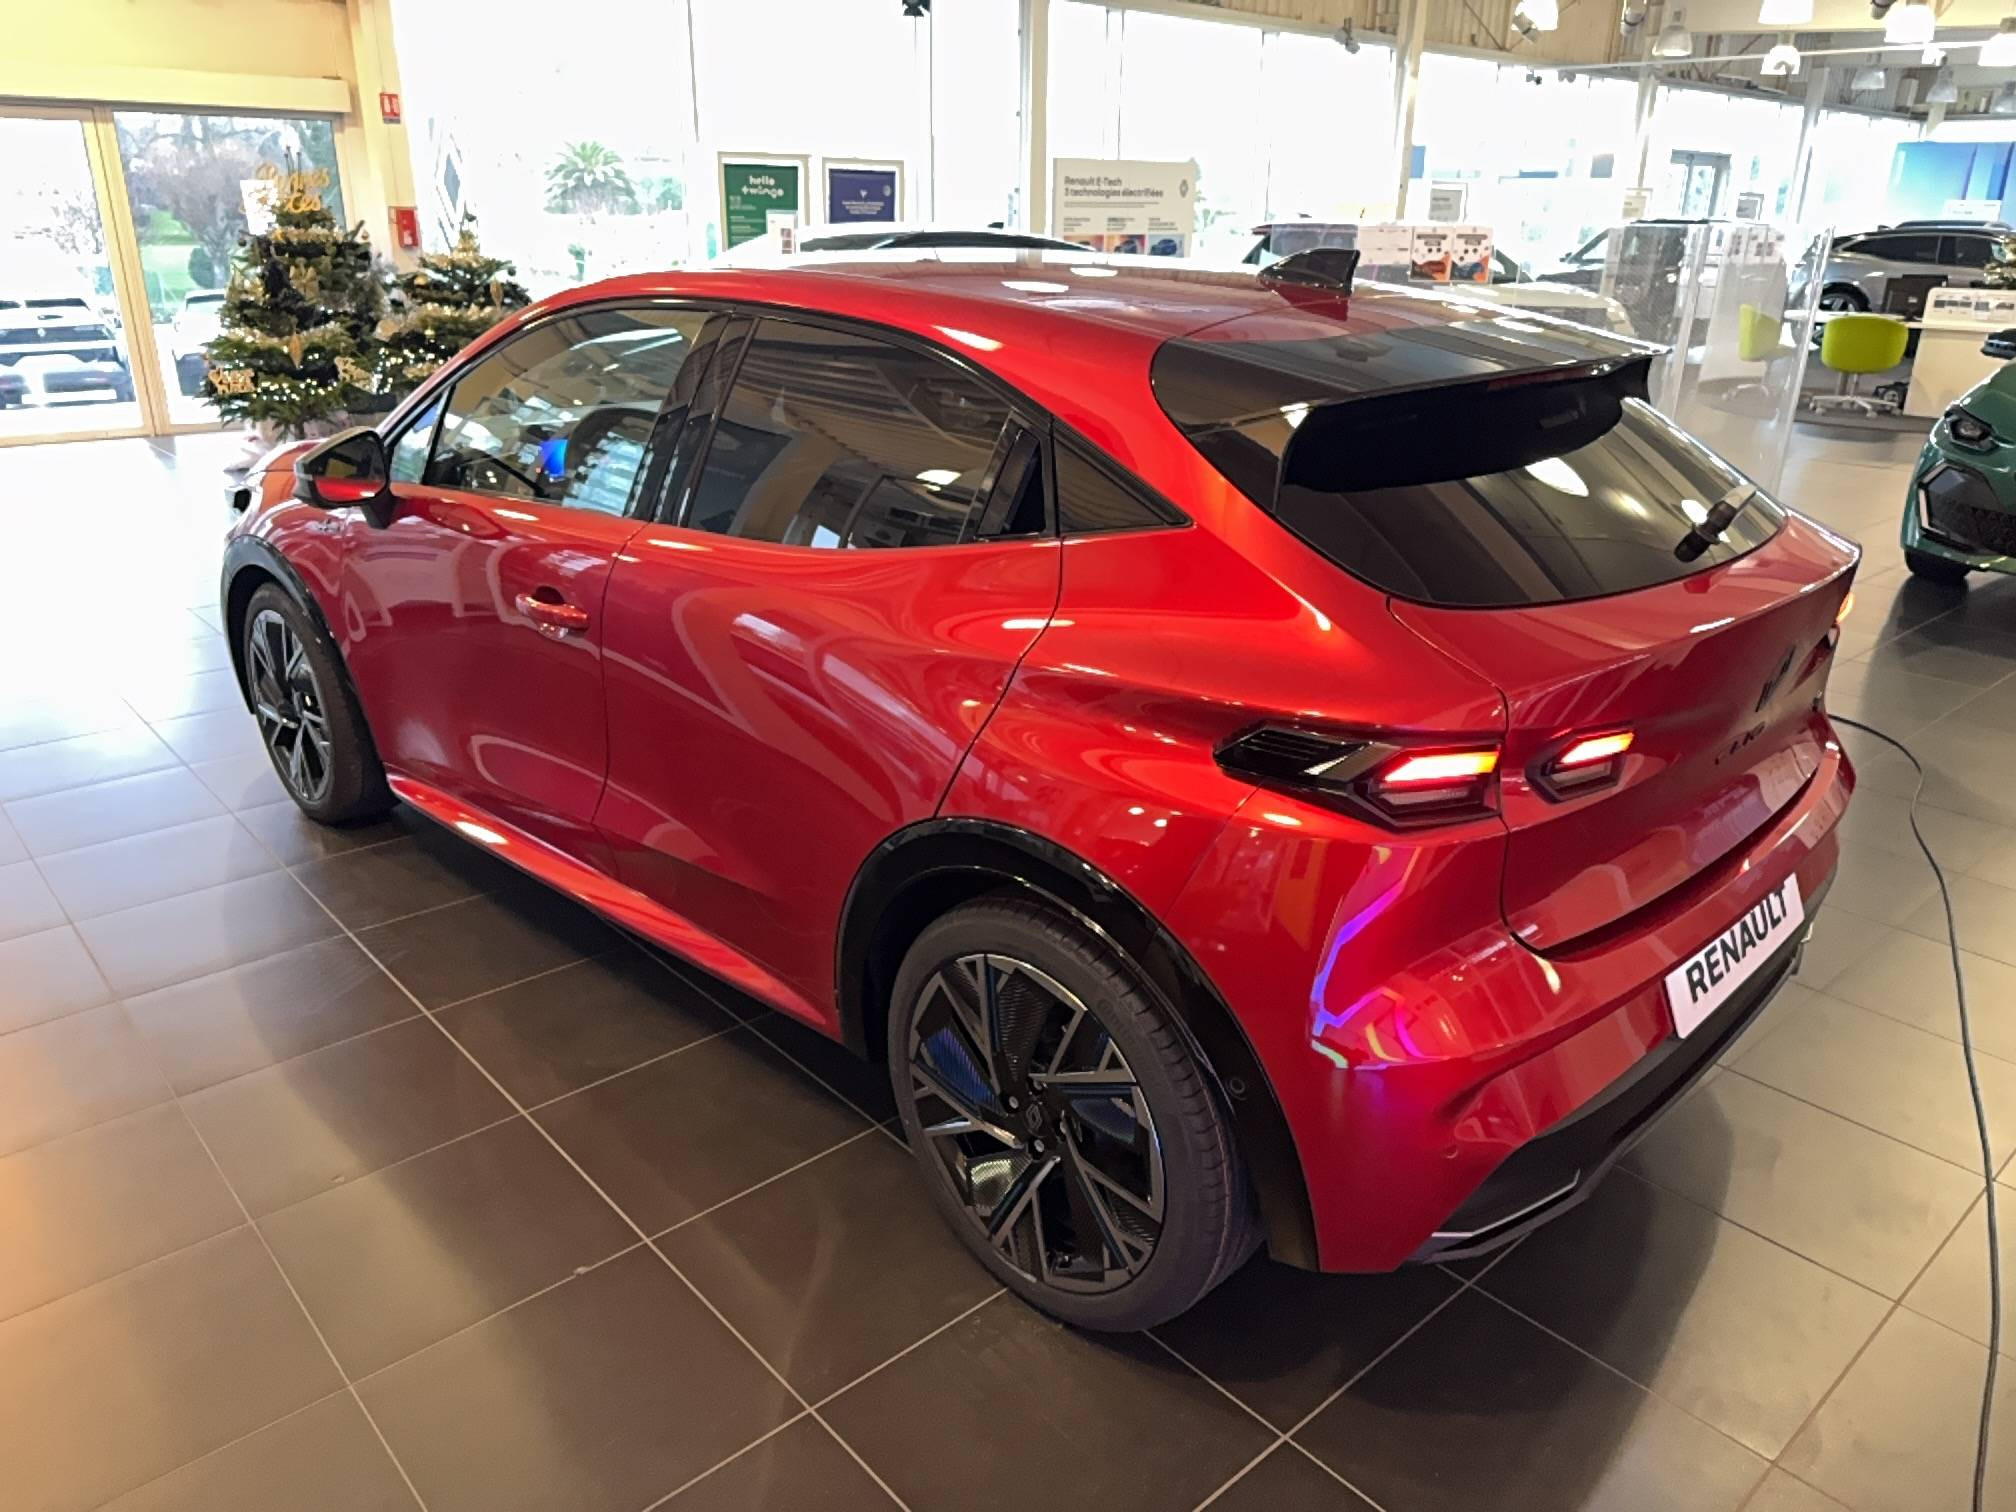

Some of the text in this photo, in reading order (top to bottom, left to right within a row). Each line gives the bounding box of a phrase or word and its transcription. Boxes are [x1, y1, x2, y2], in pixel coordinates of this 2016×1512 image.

[749, 175, 775, 186] hello
[1064, 175, 1122, 187] Renault E-Tech
[741, 185, 784, 199] twingo
[1071, 187, 1121, 199] technologies
[1685, 883, 1787, 1004] RENAULT
